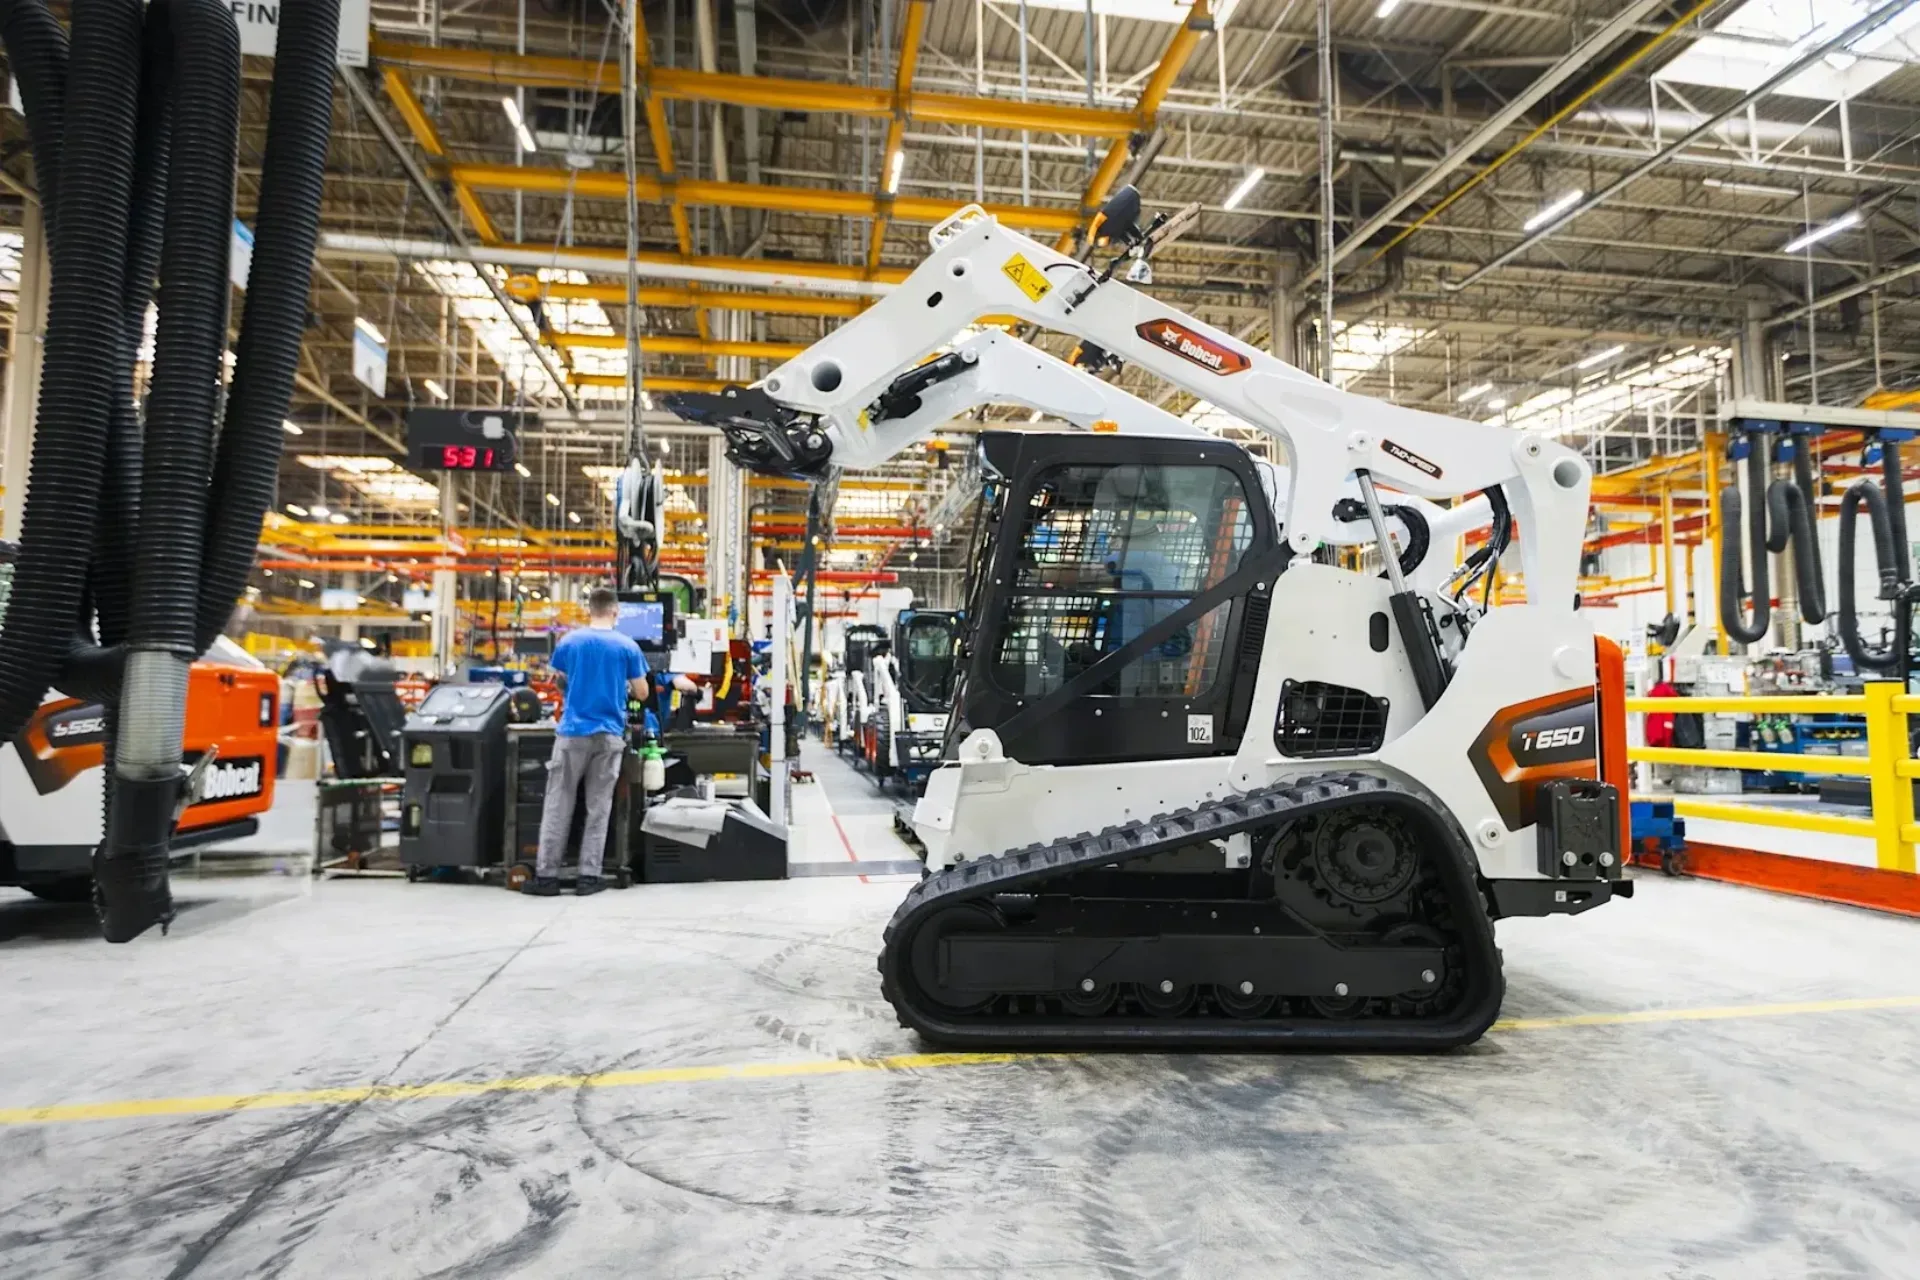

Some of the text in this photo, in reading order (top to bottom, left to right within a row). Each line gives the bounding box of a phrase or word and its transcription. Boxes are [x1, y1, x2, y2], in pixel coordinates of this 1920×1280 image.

[1179, 338, 1223, 368] Bobcat
[1189, 726, 1206, 741] 102
[1521, 725, 1586, 752] T650
[203, 761, 261, 799] Bobcat
